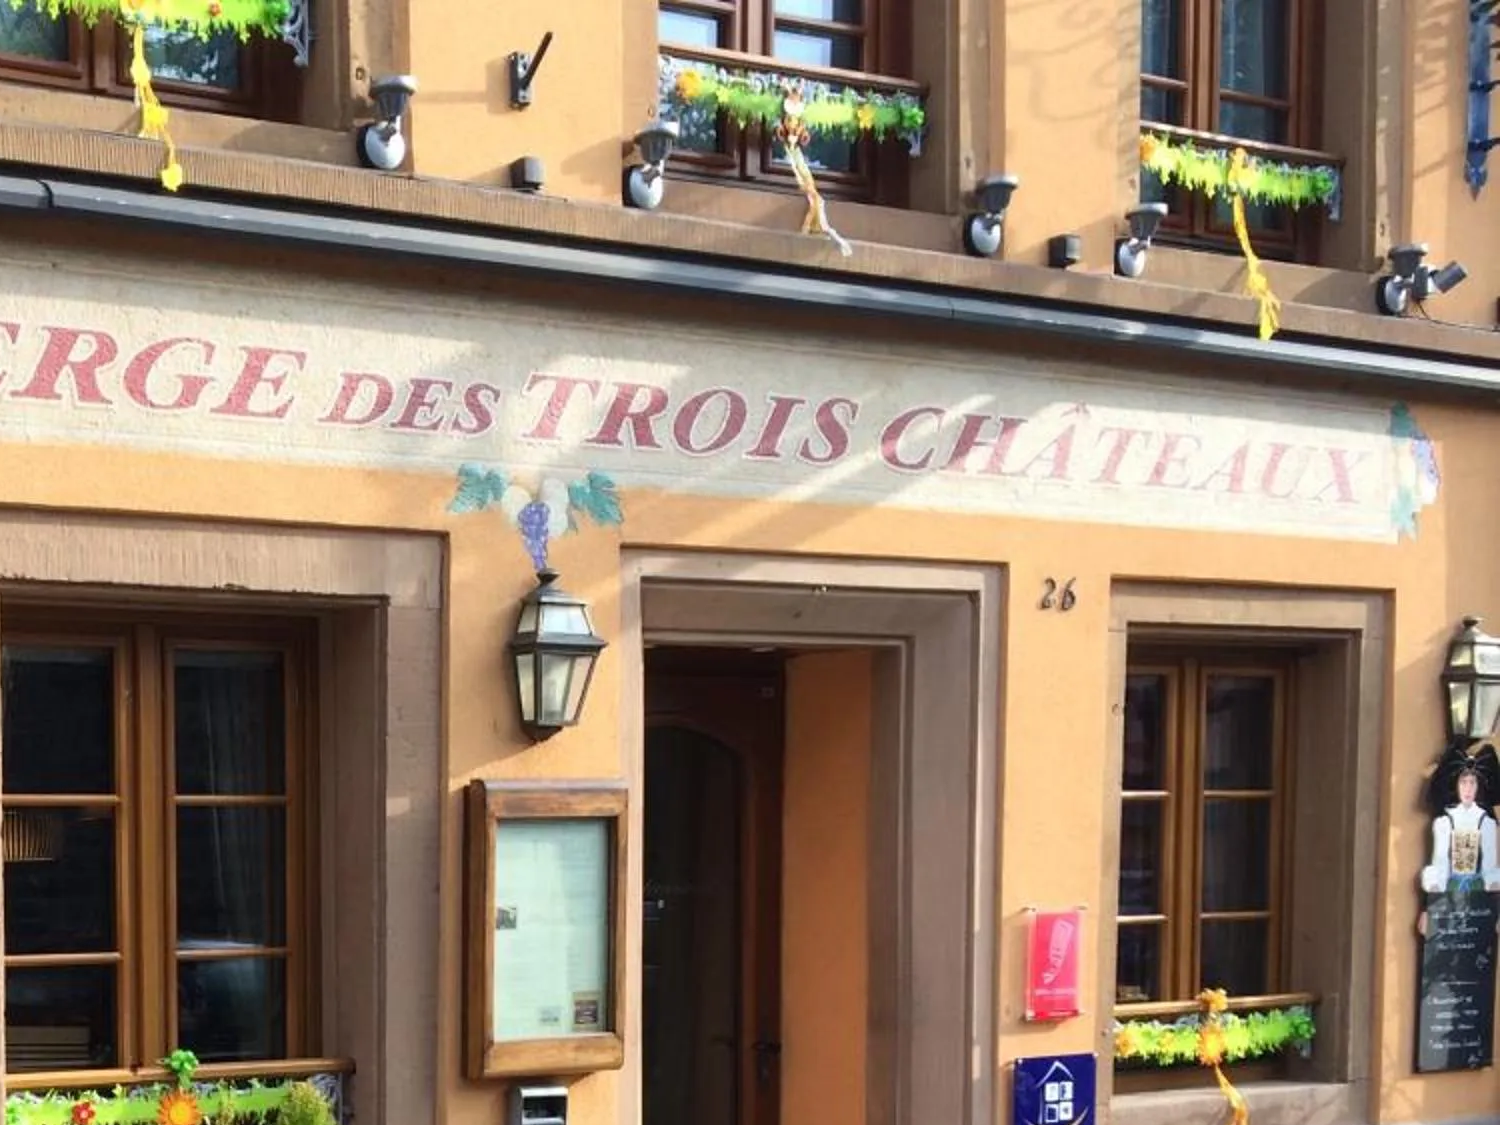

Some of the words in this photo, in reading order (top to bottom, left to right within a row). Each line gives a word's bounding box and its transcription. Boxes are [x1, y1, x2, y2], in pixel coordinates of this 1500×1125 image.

[318, 372, 501, 434] DES
[518, 372, 861, 463] TROIS
[879, 400, 1371, 504] CHÂTEAUX
[1038, 576, 1077, 611] 26
